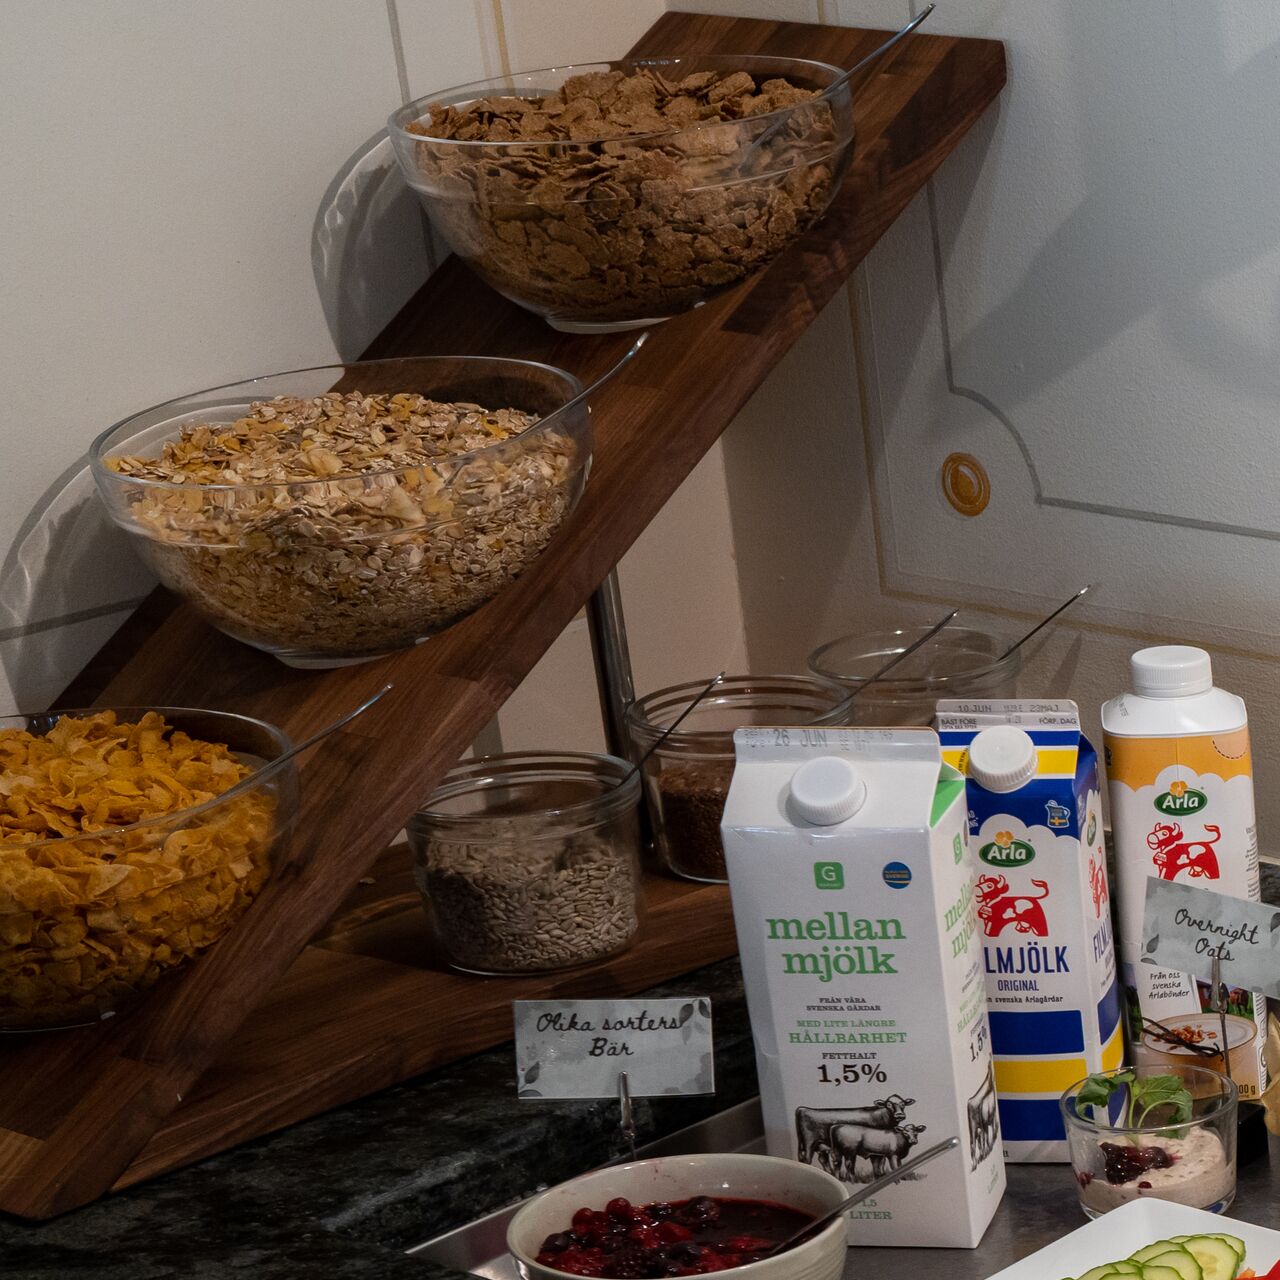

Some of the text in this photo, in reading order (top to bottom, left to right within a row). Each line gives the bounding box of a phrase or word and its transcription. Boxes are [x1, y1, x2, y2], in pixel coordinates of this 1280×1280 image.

[1162, 795, 1200, 810] Arla
[987, 847, 1027, 861] Arla
[765, 911, 907, 941] mellan
[1174, 907, 1260, 945] Overnight
[984, 941, 1071, 973] LMJÖLK
[1194, 937, 1235, 962] Oats
[782, 946, 898, 982] mjölk
[997, 979, 1040, 991] ORIGINAL
[1152, 981, 1182, 990] svenska
[1148, 989, 1190, 999] Arlabönder
[536, 1010, 682, 1033] Olika sorters
[797, 1020, 821, 1028] MED
[823, 1020, 849, 1028] LITE
[789, 1030, 908, 1044] HÅLLBARHET
[588, 1037, 634, 1057] Bär
[822, 1052, 877, 1060] FETTHALT
[816, 1063, 888, 1087] 1,5%
[850, 1210, 893, 1220] LITER
